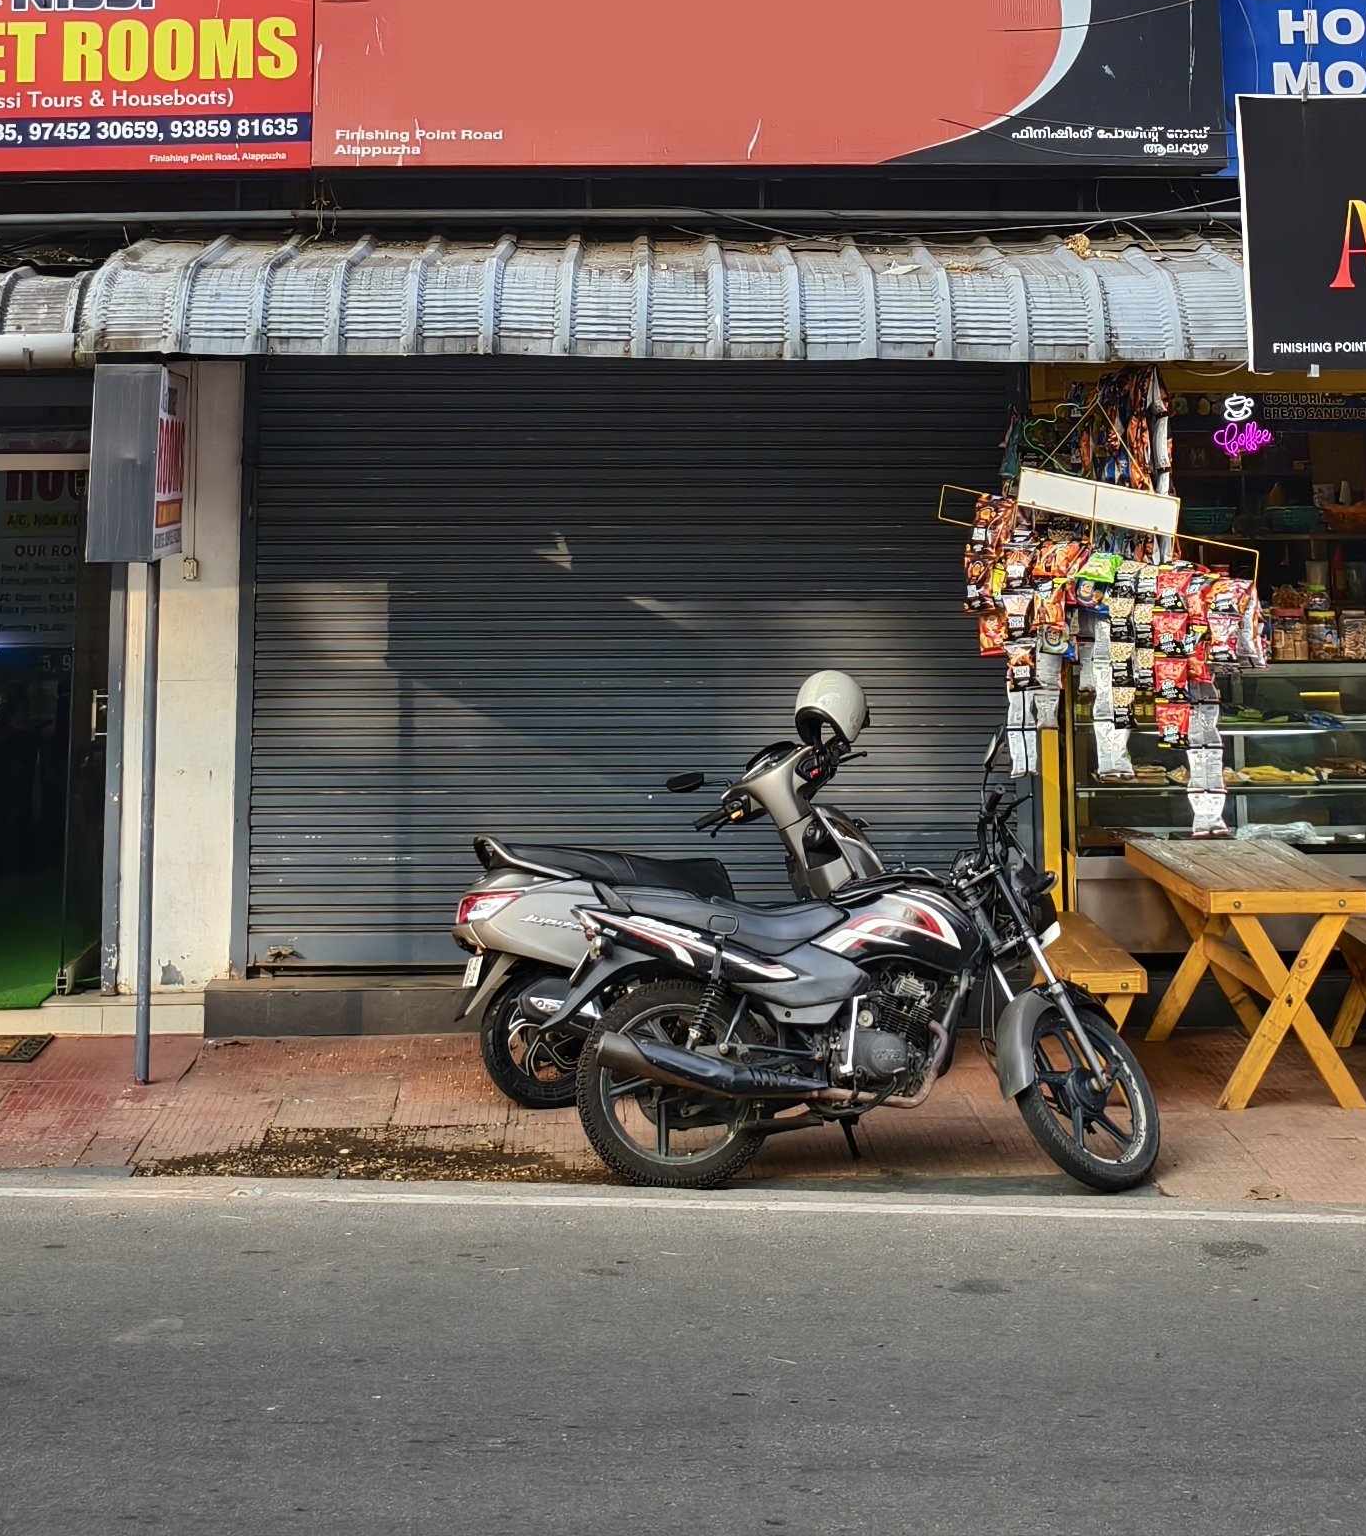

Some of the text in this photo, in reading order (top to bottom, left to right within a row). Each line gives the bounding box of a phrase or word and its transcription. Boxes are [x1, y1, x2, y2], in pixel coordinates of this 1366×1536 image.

[62, 17, 298, 82] ROOMS
[27, 91, 83, 109] Tours
[29, 122, 91, 140] 97452
[335, 129, 504, 142] Finishing Point Road
[334, 144, 421, 156] Alappuzha
[149, 151, 287, 163] Finishing Point Alappuzha
[1273, 342, 1332, 354] FINISHING
[1263, 393, 1296, 405] COOL
[1263, 407, 1304, 420] BREAD
[1213, 421, 1274, 456] Coffee
